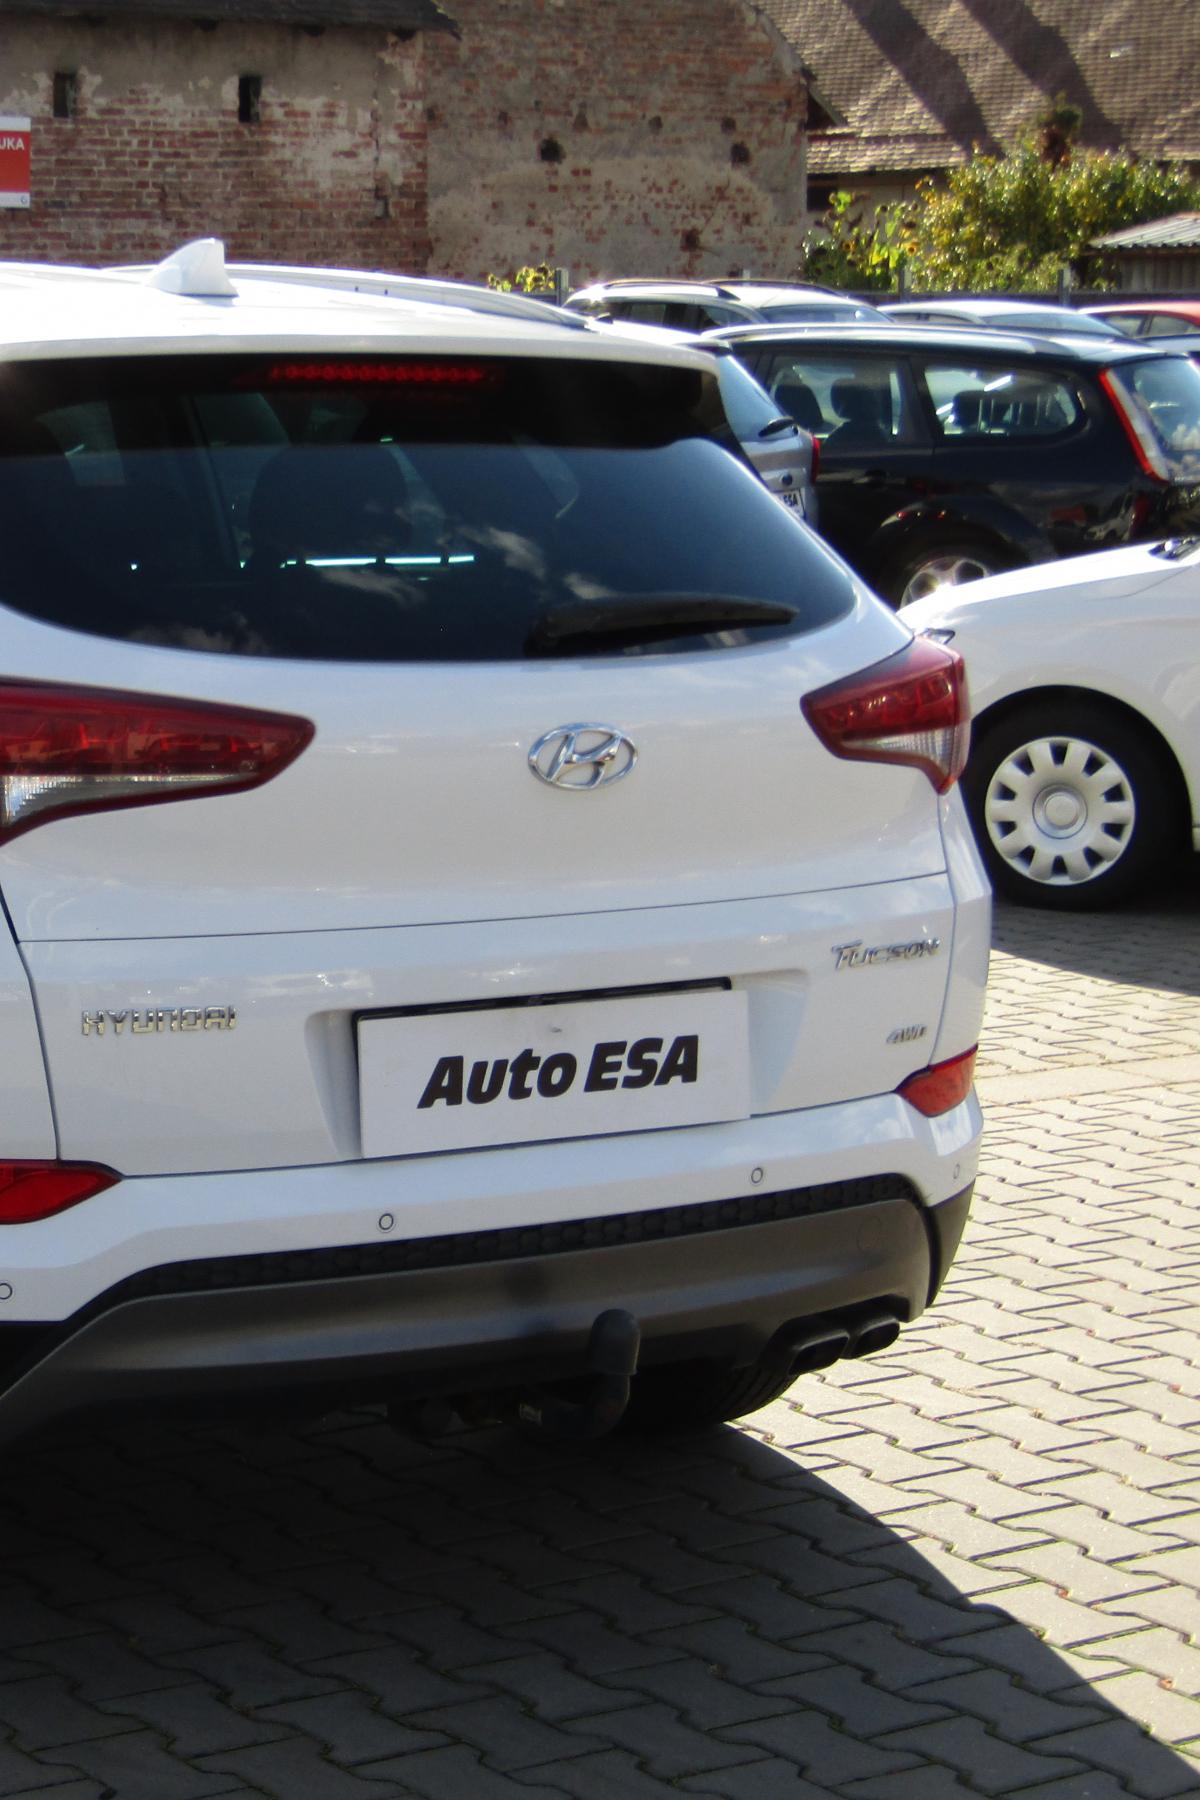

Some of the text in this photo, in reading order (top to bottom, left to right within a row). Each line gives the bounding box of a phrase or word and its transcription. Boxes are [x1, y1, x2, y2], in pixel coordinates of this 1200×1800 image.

[81, 1004, 238, 1036] HYUNDAI
[416, 1034, 699, 1109] Auto ESA
